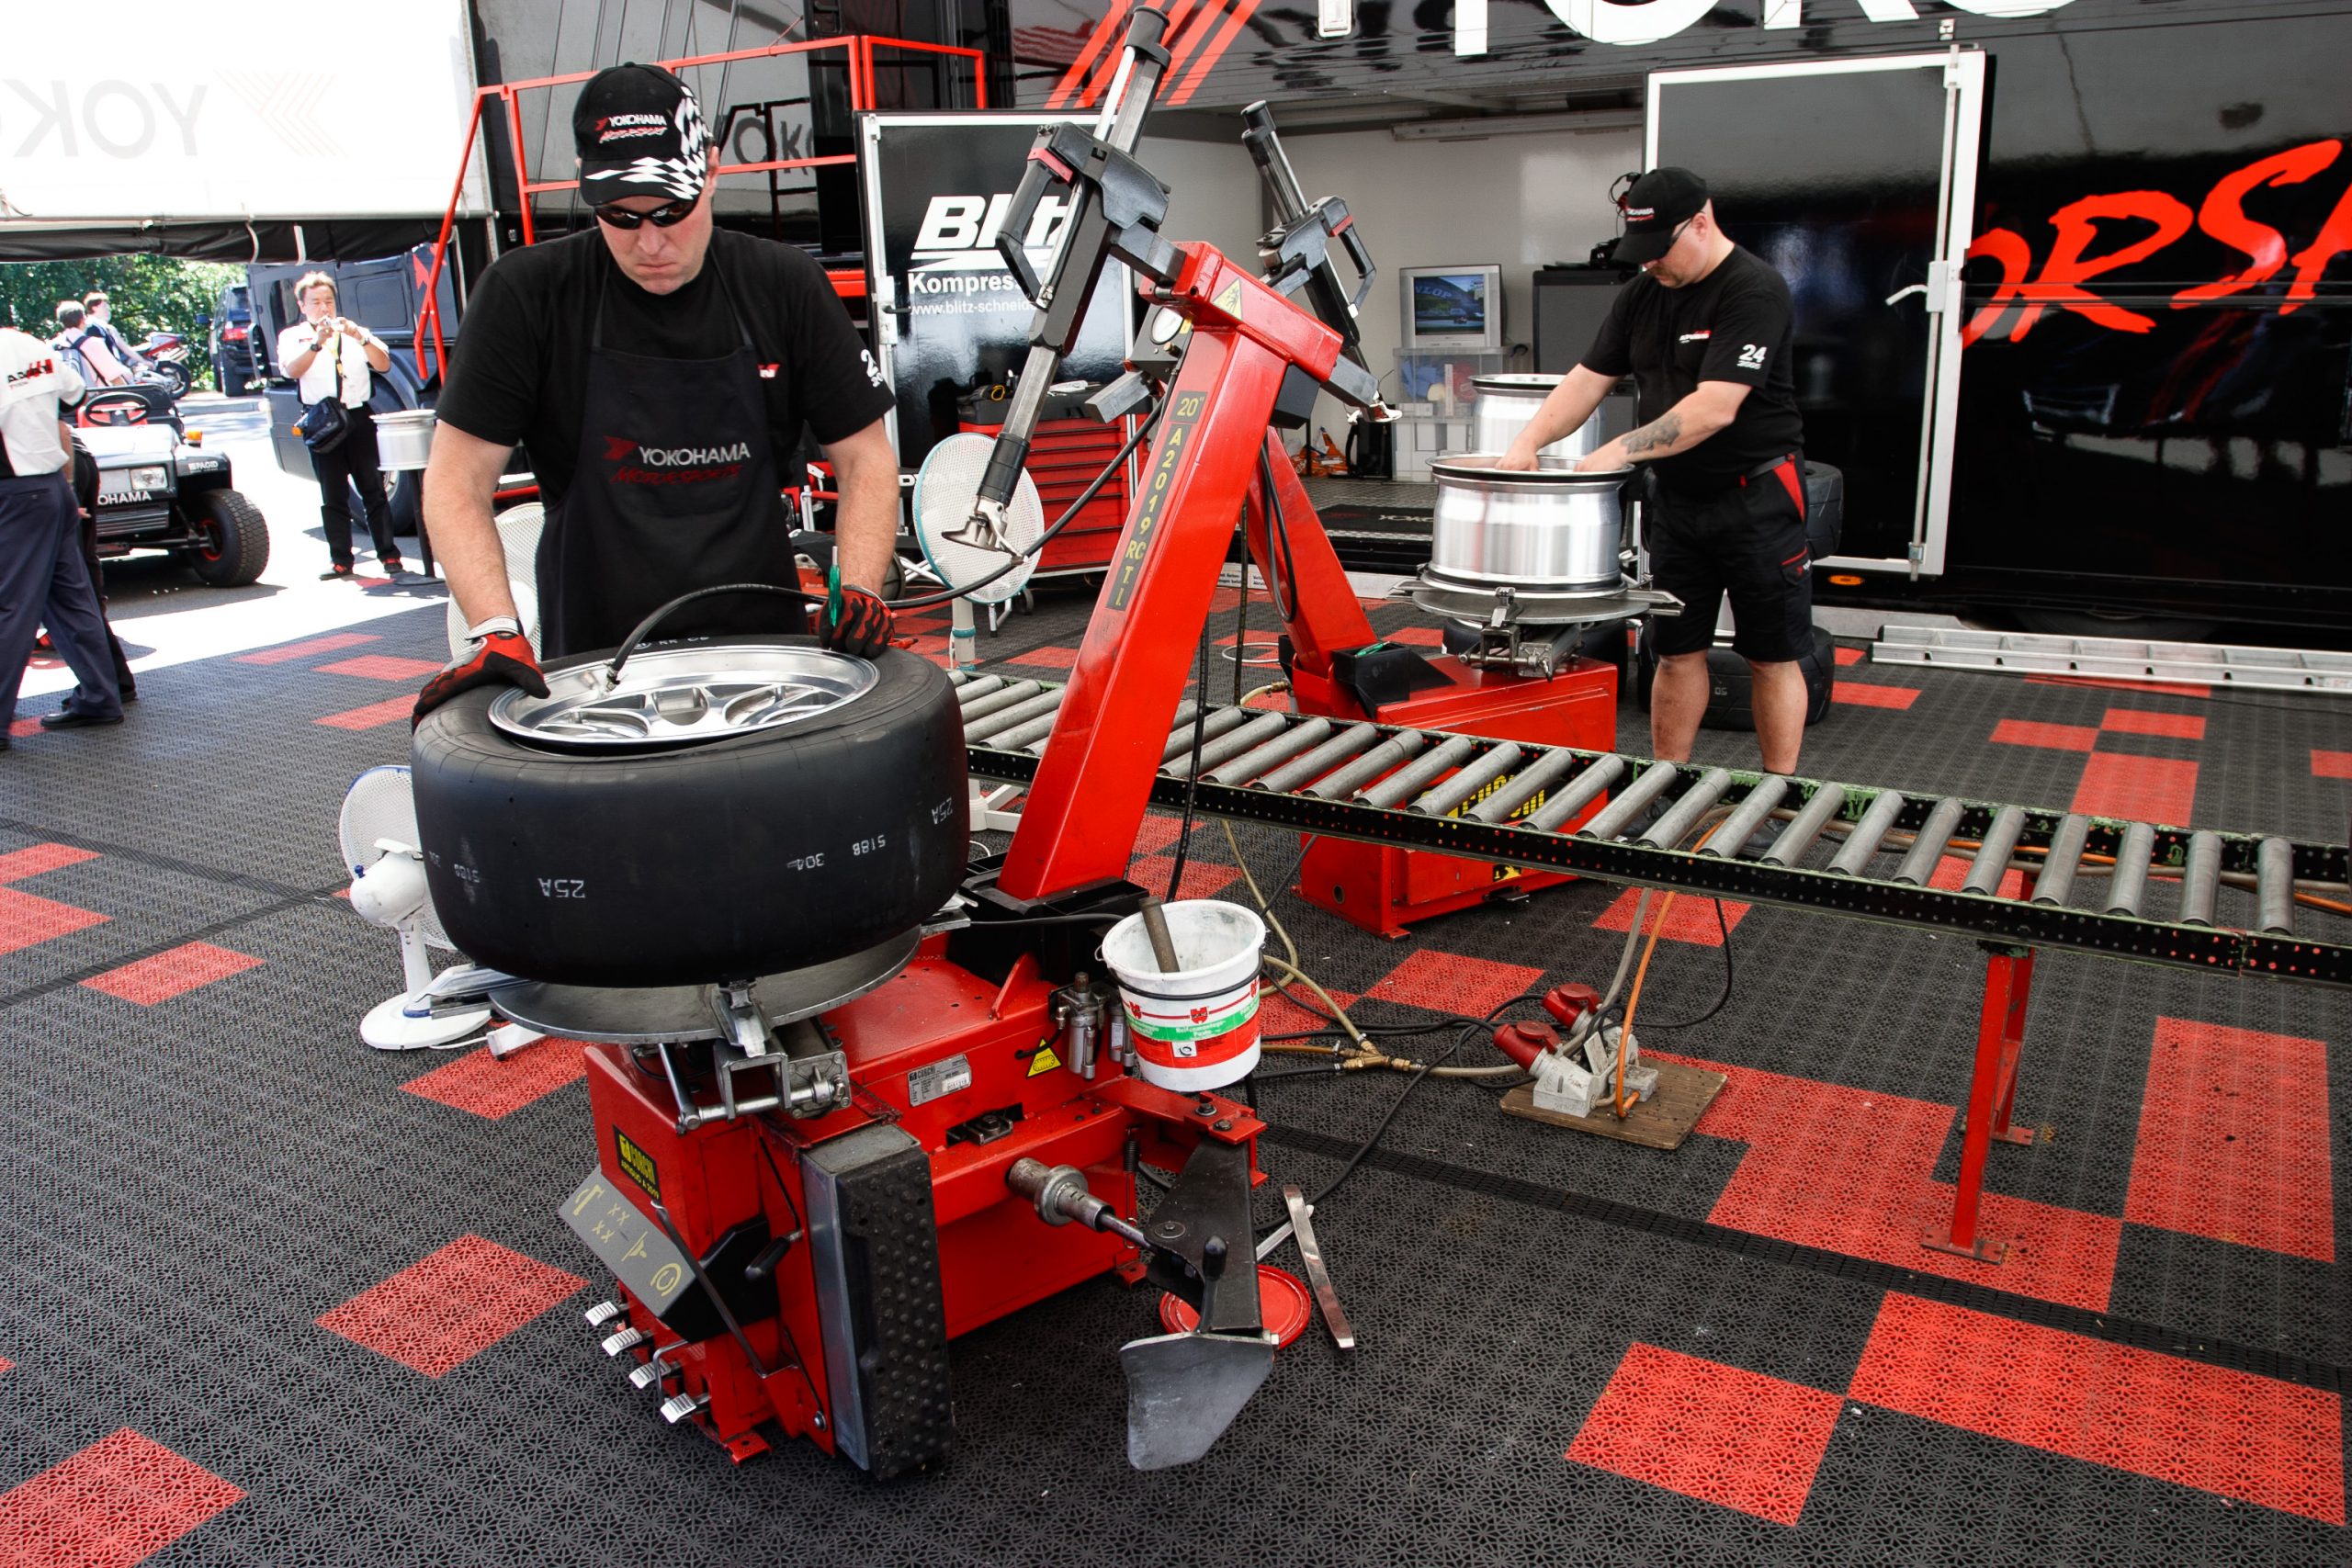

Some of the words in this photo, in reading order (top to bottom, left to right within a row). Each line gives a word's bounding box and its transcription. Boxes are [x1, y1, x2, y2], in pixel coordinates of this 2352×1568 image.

[608, 114, 667, 128] YOKOHAMA
[908, 272, 1023, 297] Kompres
[1739, 344, 1768, 364] 24
[639, 442, 751, 466] YOKOHAMA
[537, 877, 586, 899] 25A
